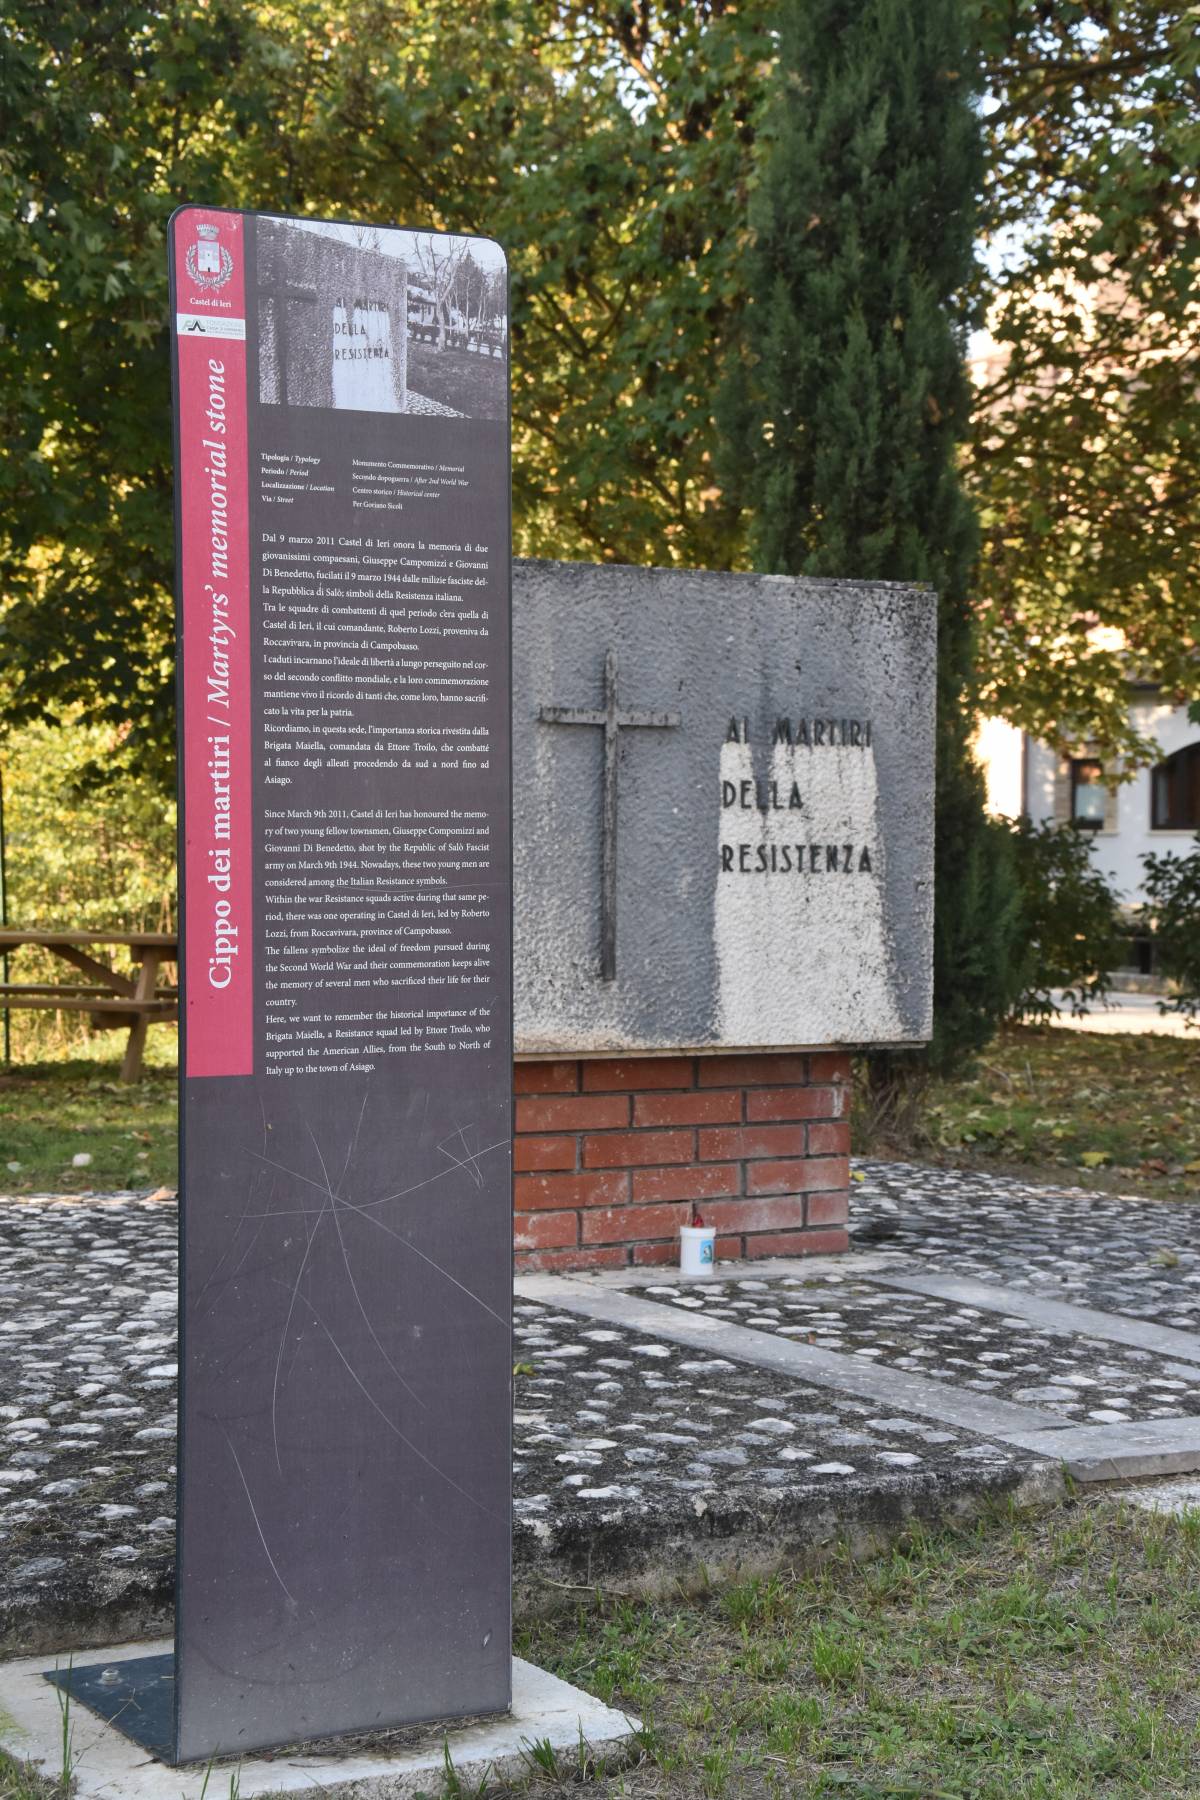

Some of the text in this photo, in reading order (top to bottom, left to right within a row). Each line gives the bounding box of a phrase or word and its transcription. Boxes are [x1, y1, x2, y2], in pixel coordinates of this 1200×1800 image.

[190, 297, 210, 306] Castel
[220, 300, 232, 308] Ieri
[208, 358, 227, 435] stone
[261, 453, 320, 465] Tipologia Typology
[352, 459, 387, 467] Monumento
[388, 462, 435, 470] Commemorativo
[352, 473, 377, 481] Secondo
[377, 475, 410, 484] dopoguerra
[262, 481, 304, 490] Localizzazione
[397, 489, 424, 497] Historical
[202, 439, 228, 579] memorial
[362, 501, 387, 509] Goriano
[387, 502, 403, 510] Sicoli
[262, 552, 311, 563] giovanissimi
[362, 556, 398, 567] Giuseppe
[400, 557, 447, 569] Campomizzi
[455, 560, 488, 569] Giovanni
[263, 585, 270, 594] la
[272, 585, 314, 598] Repubblica
[316, 587, 324, 596] di
[346, 589, 374, 598] simboli
[376, 590, 394, 599] della
[396, 591, 433, 600] Resistenza
[324, 640, 359, 651] provincia
[361, 640, 368, 648] di
[274, 672, 286, 680] del
[288, 672, 320, 681] secondo
[321, 673, 354, 682] conflitto
[399, 675, 407, 683] la
[408, 676, 424, 684] loro
[207, 716, 231, 727] /
[726, 716, 872, 747] AI MARTIRI
[264, 741, 292, 751] Brigata
[329, 741, 371, 750] comandata
[374, 742, 384, 750] da
[387, 743, 411, 751] Ettore
[441, 743, 454, 751] che
[207, 734, 231, 840] martiri
[722, 780, 804, 811] DELLA
[265, 829, 274, 837] ry
[275, 826, 283, 835] of
[300, 829, 325, 837] young
[326, 826, 349, 835] fellow
[393, 827, 428, 837] Giuseppe
[476, 826, 490, 834] and
[265, 844, 300, 852] Giovanni
[304, 844, 313, 852] Di
[378, 844, 387, 853] by
[389, 843, 401, 851] the
[404, 843, 436, 854] Republic
[439, 843, 446, 851] of
[449, 843, 464, 851] Salò
[467, 843, 489, 851] Fascist
[721, 843, 873, 874] RESISTENZA
[207, 847, 231, 892] dei
[265, 877, 307, 886] considered
[309, 880, 335, 888] among
[337, 877, 349, 885] the
[351, 877, 374, 885] Italian
[377, 877, 415, 885] Resistance
[291, 929, 309, 937] from
[361, 928, 393, 938] province
[395, 927, 402, 935] of
[208, 899, 239, 989] Cippo
[266, 947, 280, 955] The
[284, 946, 308, 954] fallens
[312, 945, 349, 956] symbolize
[369, 944, 386, 952] ideal
[390, 944, 397, 952] of
[400, 943, 431, 951] freedom
[434, 942, 463, 953] pursued
[466, 942, 490, 952] during
[265, 958, 490, 972] the Second World War and their commemoration keeps alive
[266, 1032, 293, 1043] Brigata
[336, 1029, 374, 1038] Resistance
[376, 1027, 398, 1038] squad
[401, 1027, 412, 1035] led
[414, 1026, 423, 1037] by
[426, 1026, 447, 1034] Ettore
[475, 1024, 490, 1032] who
[266, 1048, 304, 1060] supported
[307, 1047, 320, 1056] the
[322, 1046, 360, 1055] American
[389, 1043, 407, 1052] from
[410, 1043, 422, 1051] the
[424, 1042, 446, 1051] South
[459, 1041, 481, 1049] North
[483, 1040, 490, 1048] of
